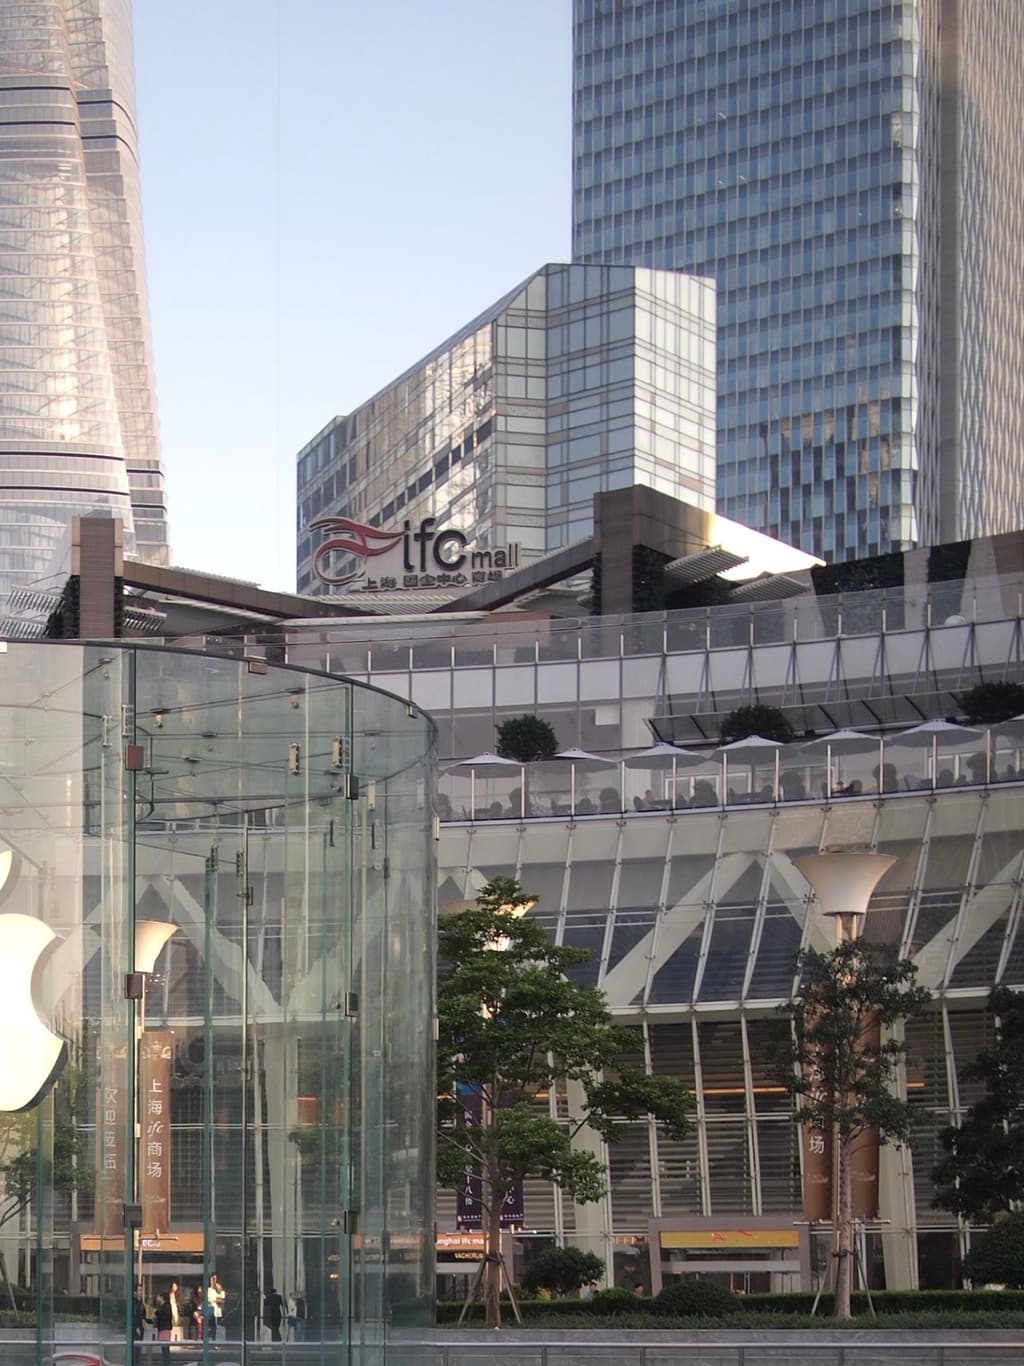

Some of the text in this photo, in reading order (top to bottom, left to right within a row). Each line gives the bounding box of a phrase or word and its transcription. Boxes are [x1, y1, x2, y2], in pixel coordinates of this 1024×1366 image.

[403, 517, 519, 572] ifc mall
[146, 1079, 164, 1178] 上海ifc商场
